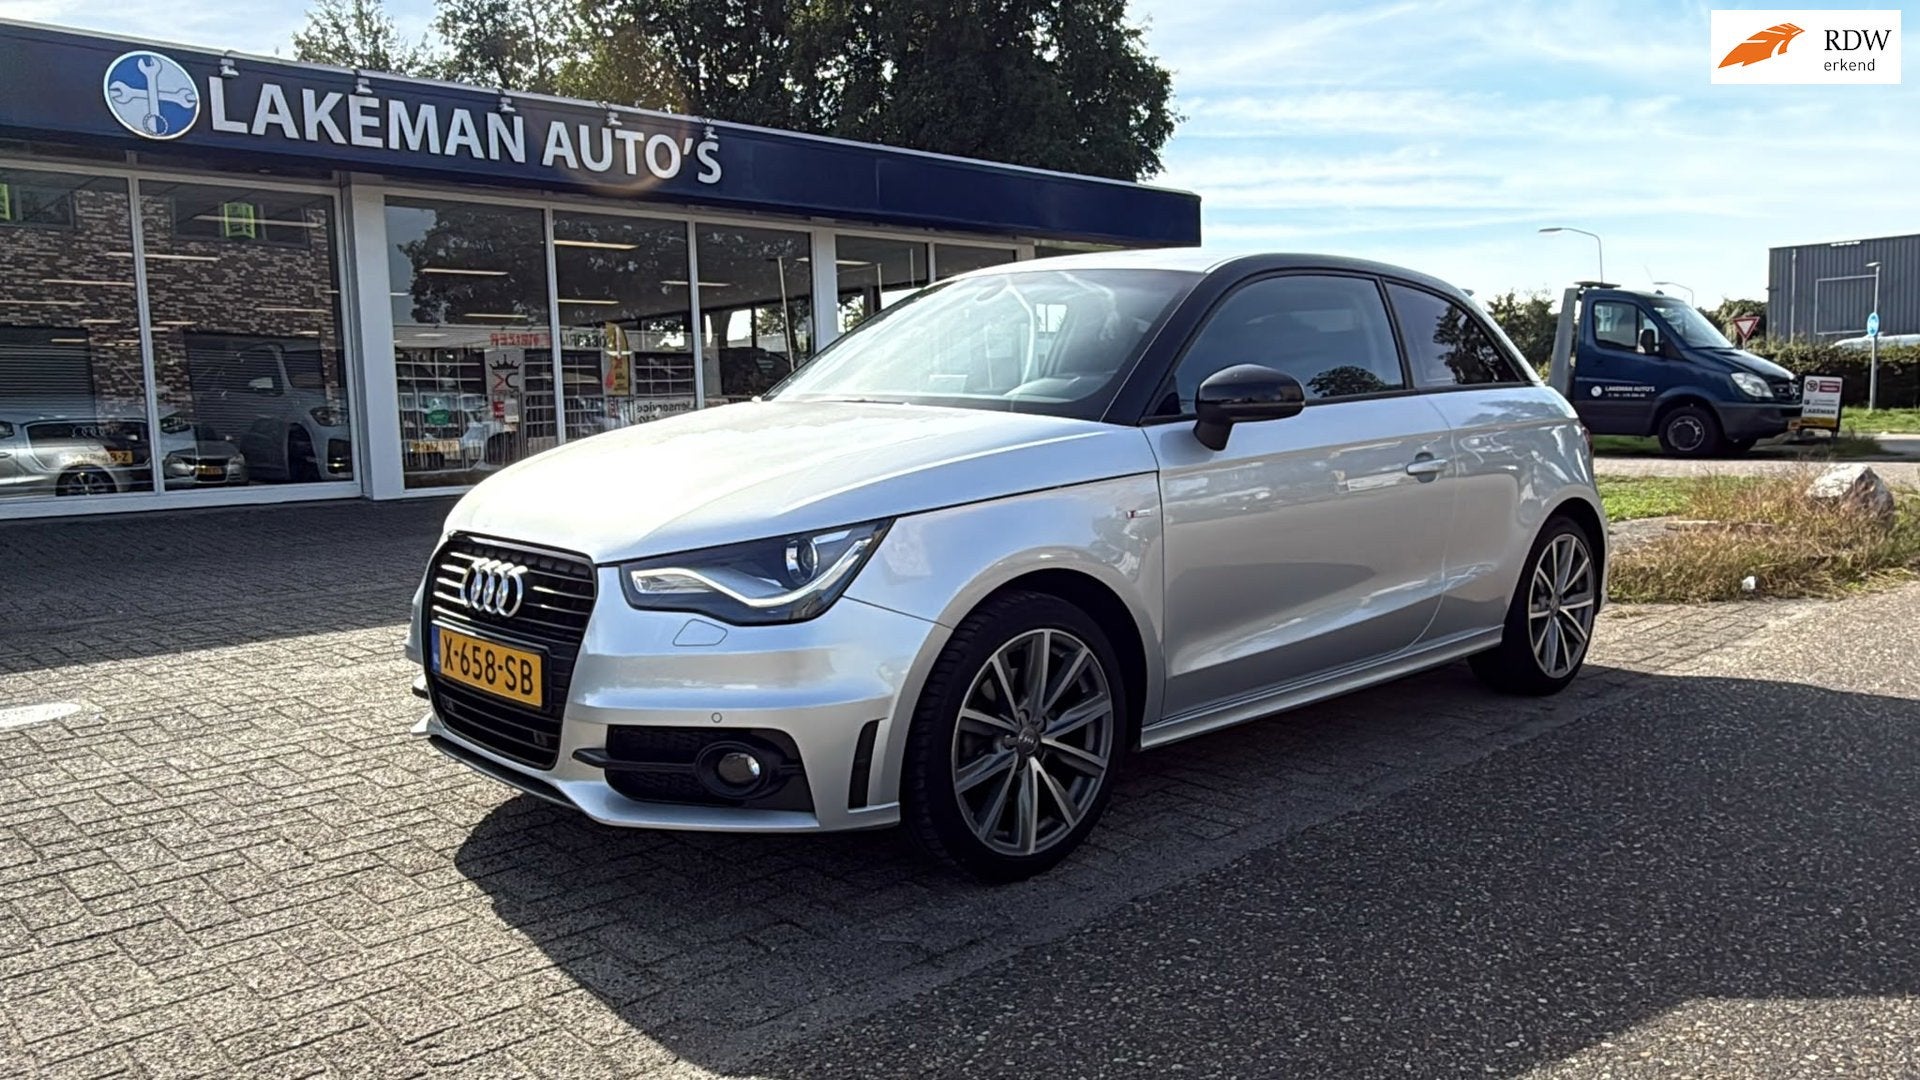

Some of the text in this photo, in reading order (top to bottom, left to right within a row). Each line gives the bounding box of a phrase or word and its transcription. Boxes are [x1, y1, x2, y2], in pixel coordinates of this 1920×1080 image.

[208, 76, 723, 185] LAKEMAN AUTO'S
[443, 634, 534, 696] X-658-SB
